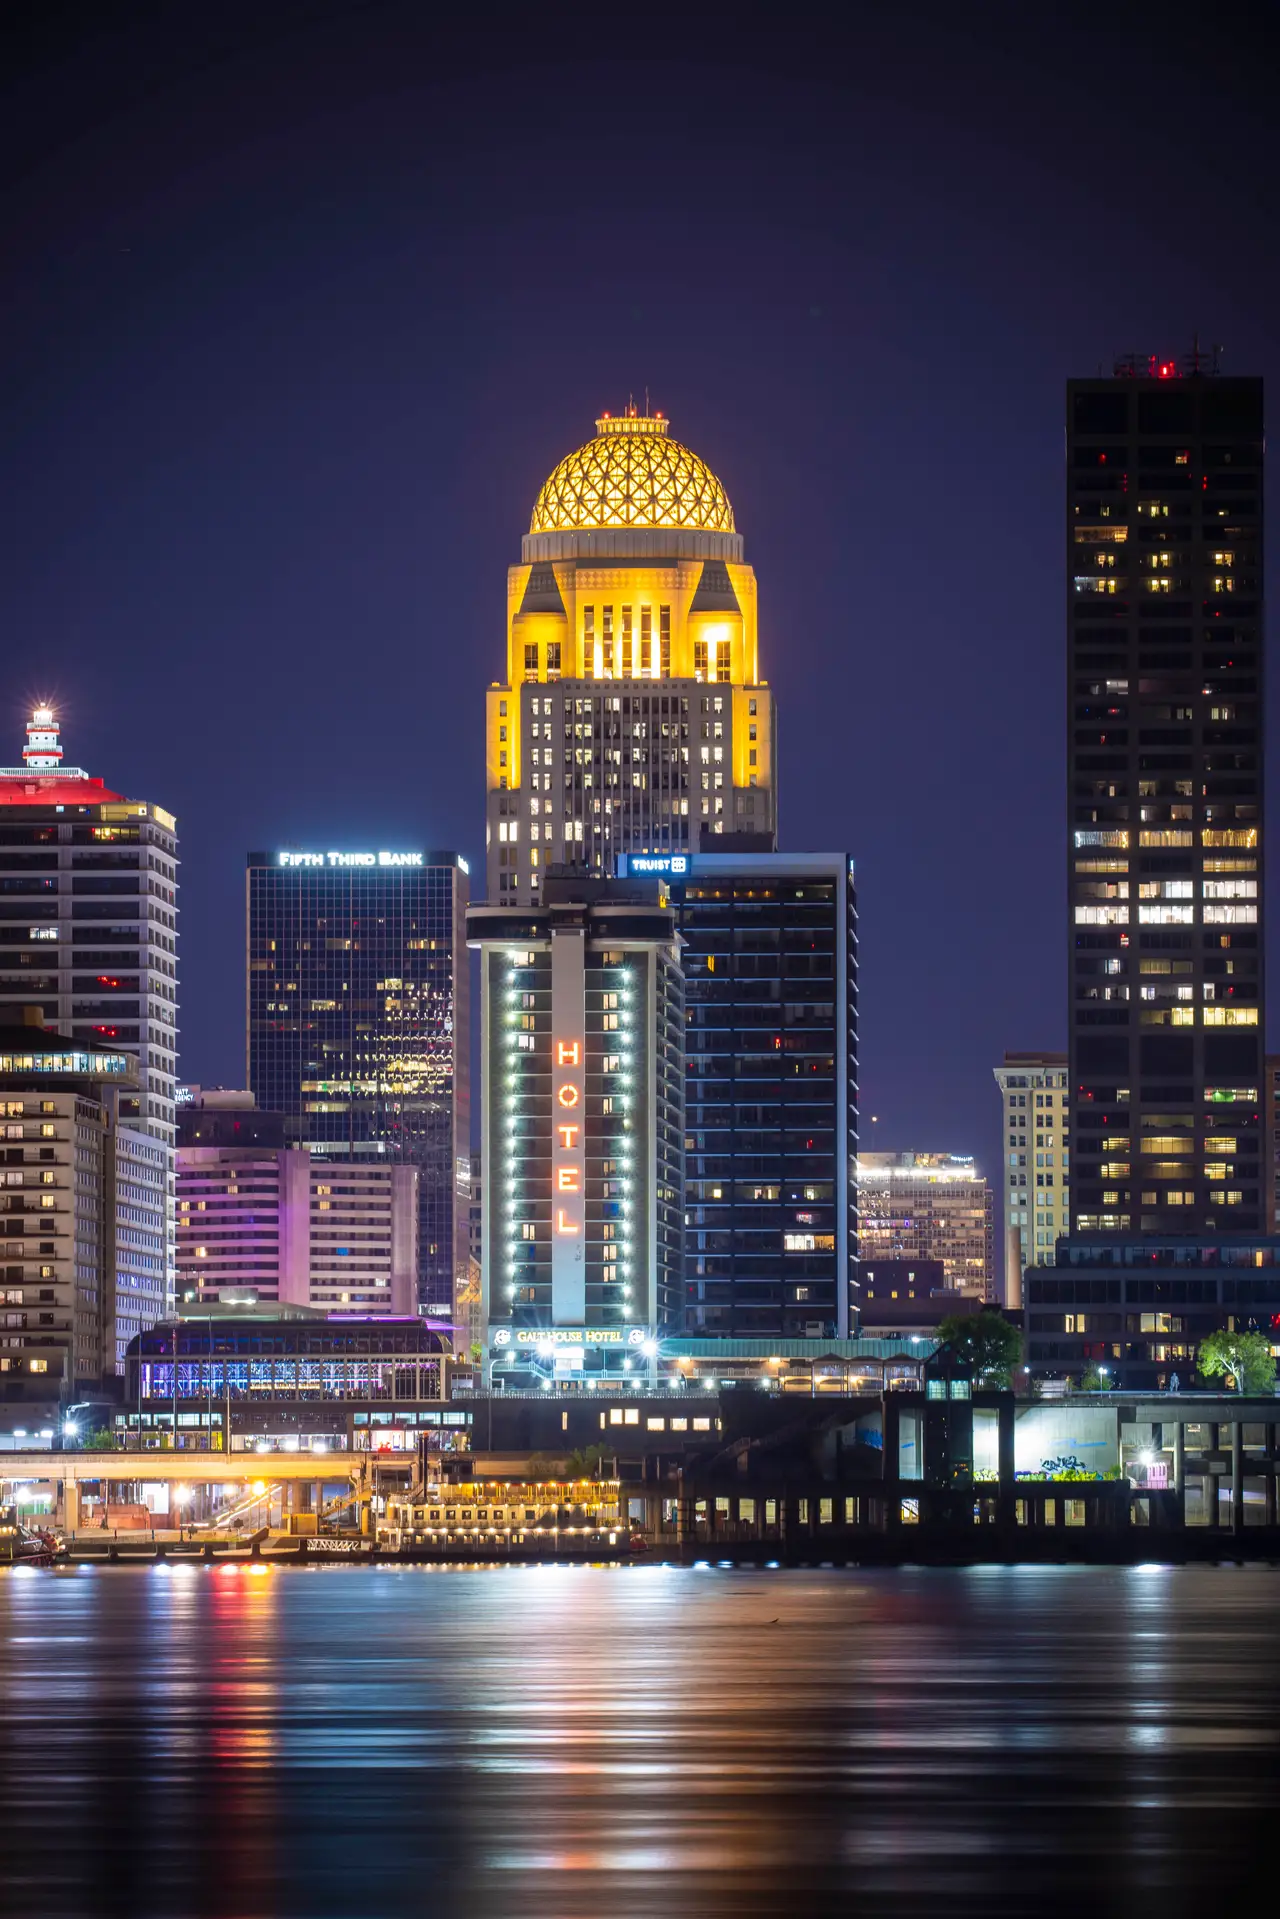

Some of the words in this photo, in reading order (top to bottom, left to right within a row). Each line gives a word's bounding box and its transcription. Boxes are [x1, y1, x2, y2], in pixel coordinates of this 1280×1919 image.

[279, 852, 323, 866] FIFTH
[327, 852, 375, 866] THIRD
[379, 852, 422, 866] BANK
[632, 859, 670, 870] TRUIST
[558, 1042, 578, 1232] HOTEL
[517, 1331, 546, 1342] GALT
[547, 1331, 582, 1342] HOUSE
[585, 1331, 623, 1342] HOTEL
